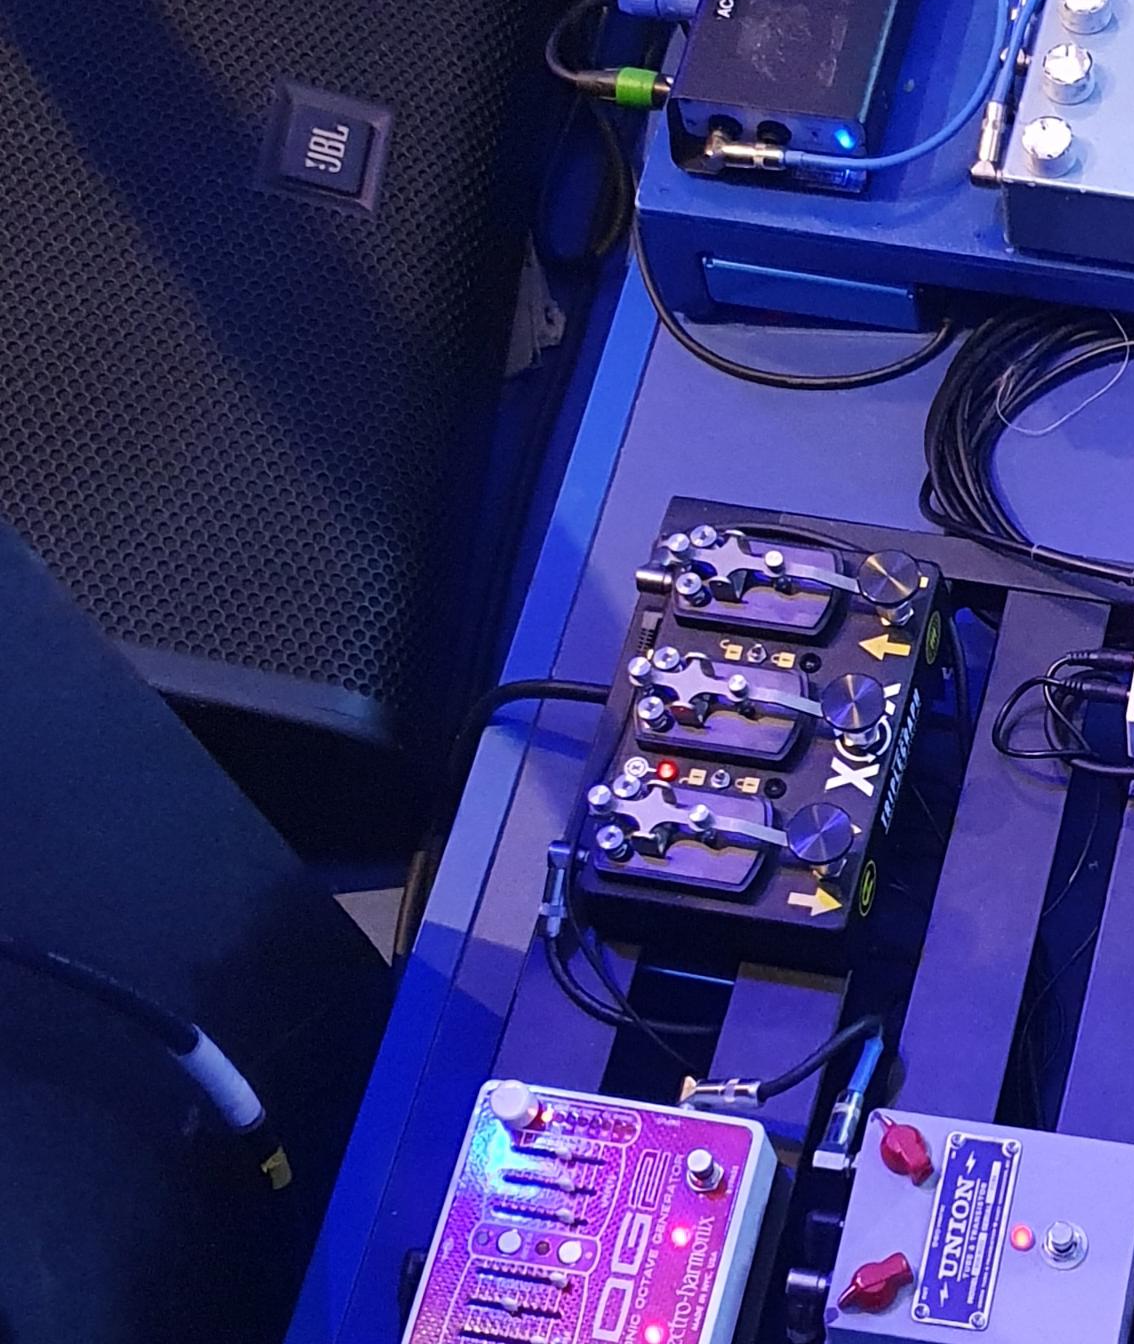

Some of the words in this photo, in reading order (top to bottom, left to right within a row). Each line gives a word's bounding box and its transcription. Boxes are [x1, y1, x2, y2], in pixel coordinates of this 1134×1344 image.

[305, 124, 349, 173] JBL
[636, 1249, 659, 1308] OCTAVE
[653, 1153, 684, 1244] GENERATOR
[938, 1176, 973, 1279] UNION
